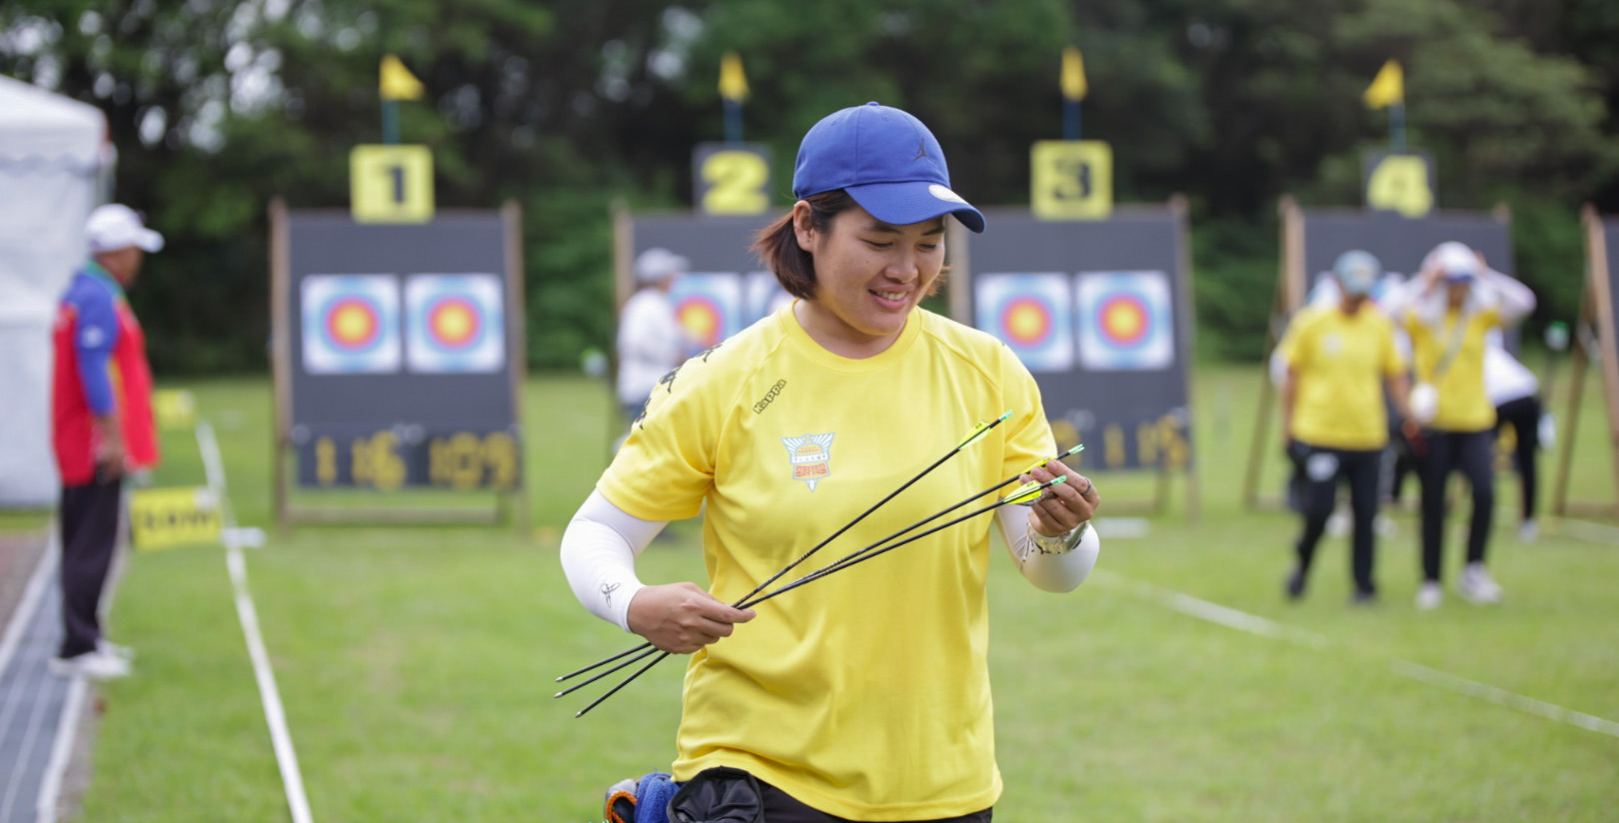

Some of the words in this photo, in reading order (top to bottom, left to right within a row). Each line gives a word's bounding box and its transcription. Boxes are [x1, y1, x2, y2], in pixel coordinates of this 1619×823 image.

[380, 165, 406, 204] 1
[702, 151, 768, 215] 2
[1053, 160, 1092, 201] 3
[1367, 155, 1434, 218] 4
[753, 379, 787, 414] Kappa
